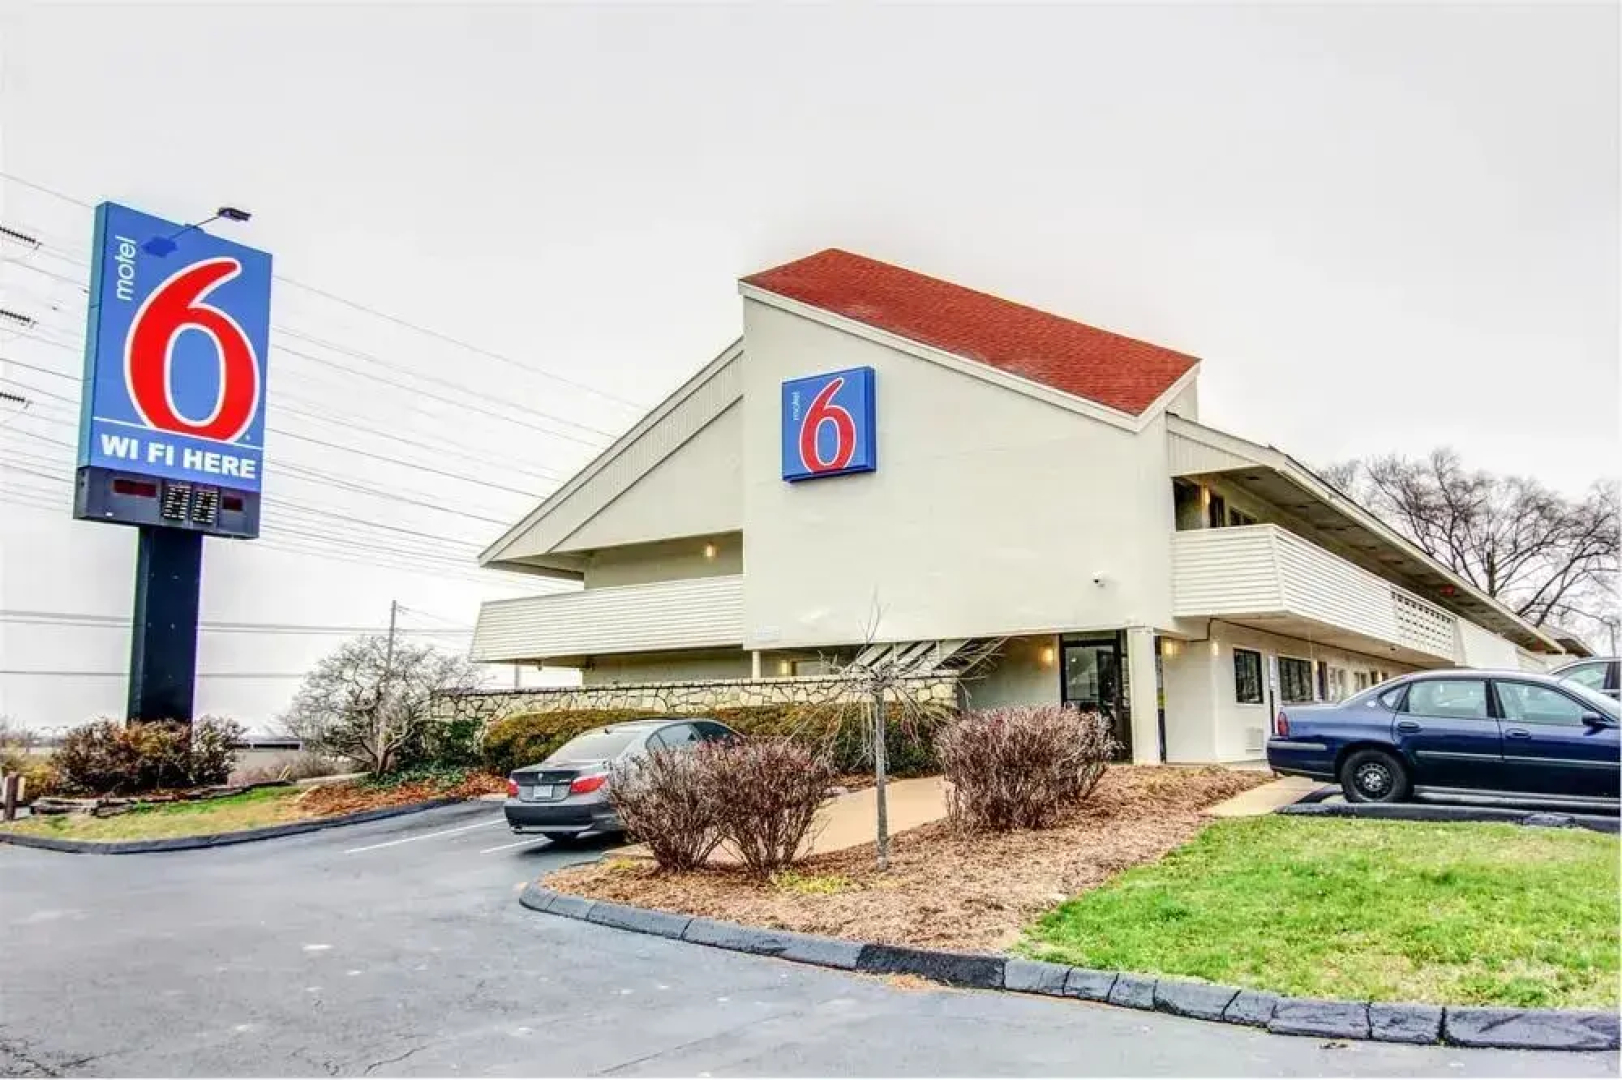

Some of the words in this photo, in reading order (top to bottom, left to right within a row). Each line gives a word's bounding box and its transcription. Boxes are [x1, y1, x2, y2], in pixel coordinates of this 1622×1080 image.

[114, 234, 136, 301] motel
[123, 256, 259, 443] 6
[101, 433, 139, 460] WI
[147, 442, 175, 467] FI
[183, 448, 256, 479] HERE
[798, 377, 857, 473] 6
